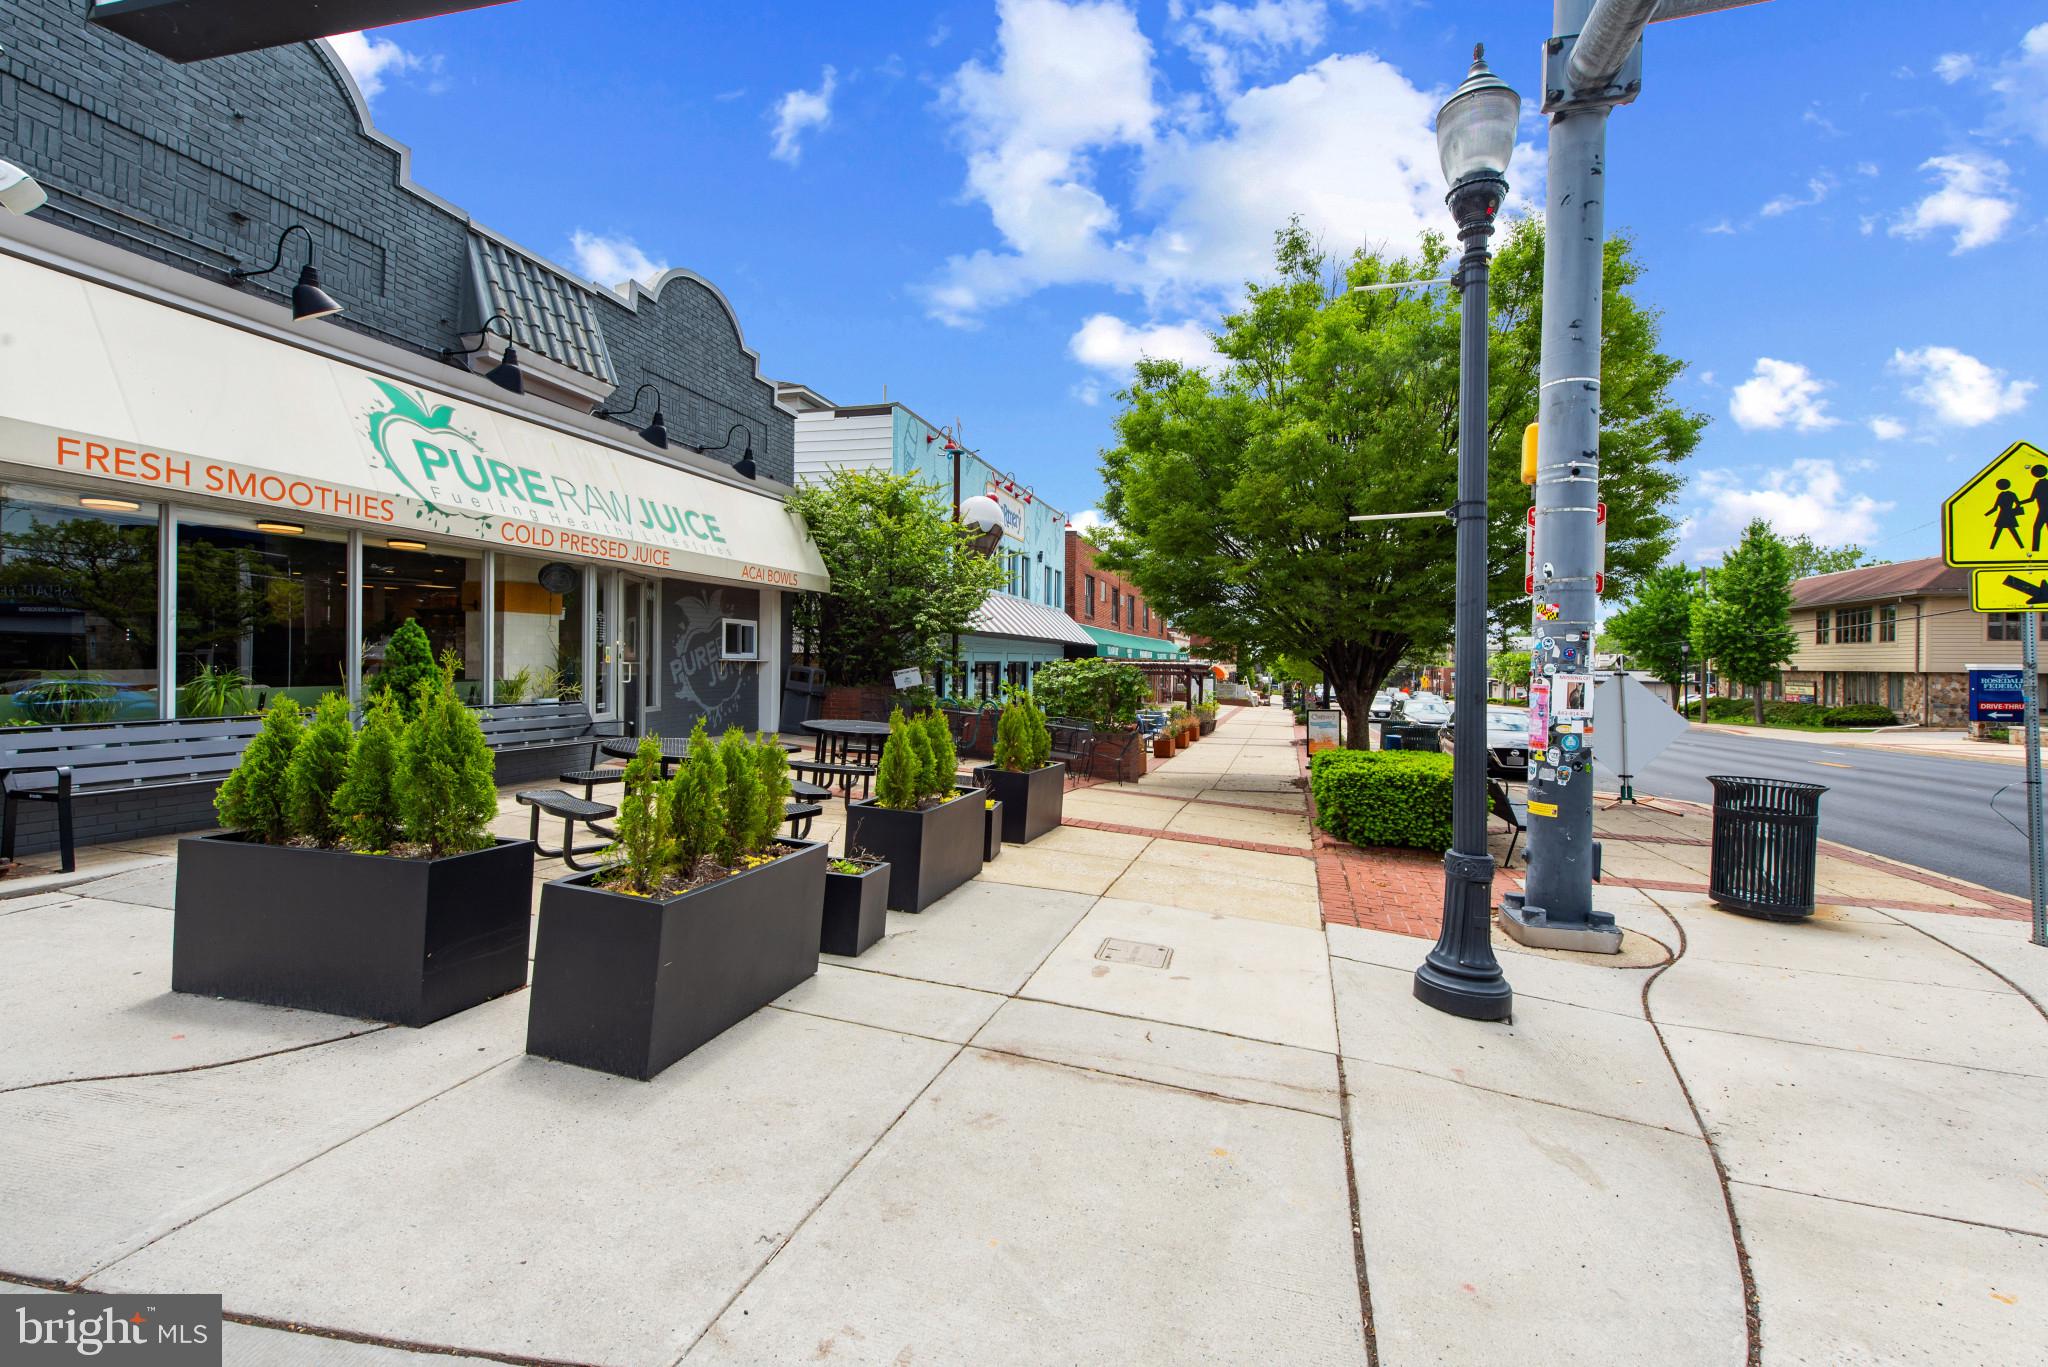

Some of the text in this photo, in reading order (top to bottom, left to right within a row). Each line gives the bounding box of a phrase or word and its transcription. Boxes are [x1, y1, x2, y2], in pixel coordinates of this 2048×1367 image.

[57, 436, 394, 522] FRESH SMOOTHIES
[412, 438, 727, 544] PURE RAW JUICE
[430, 486, 539, 522] Fueling
[550, 511, 634, 541] Healthy
[501, 522, 671, 567] COLD PRESSED JUICE
[741, 565, 798, 586] ACAI BOWLS
